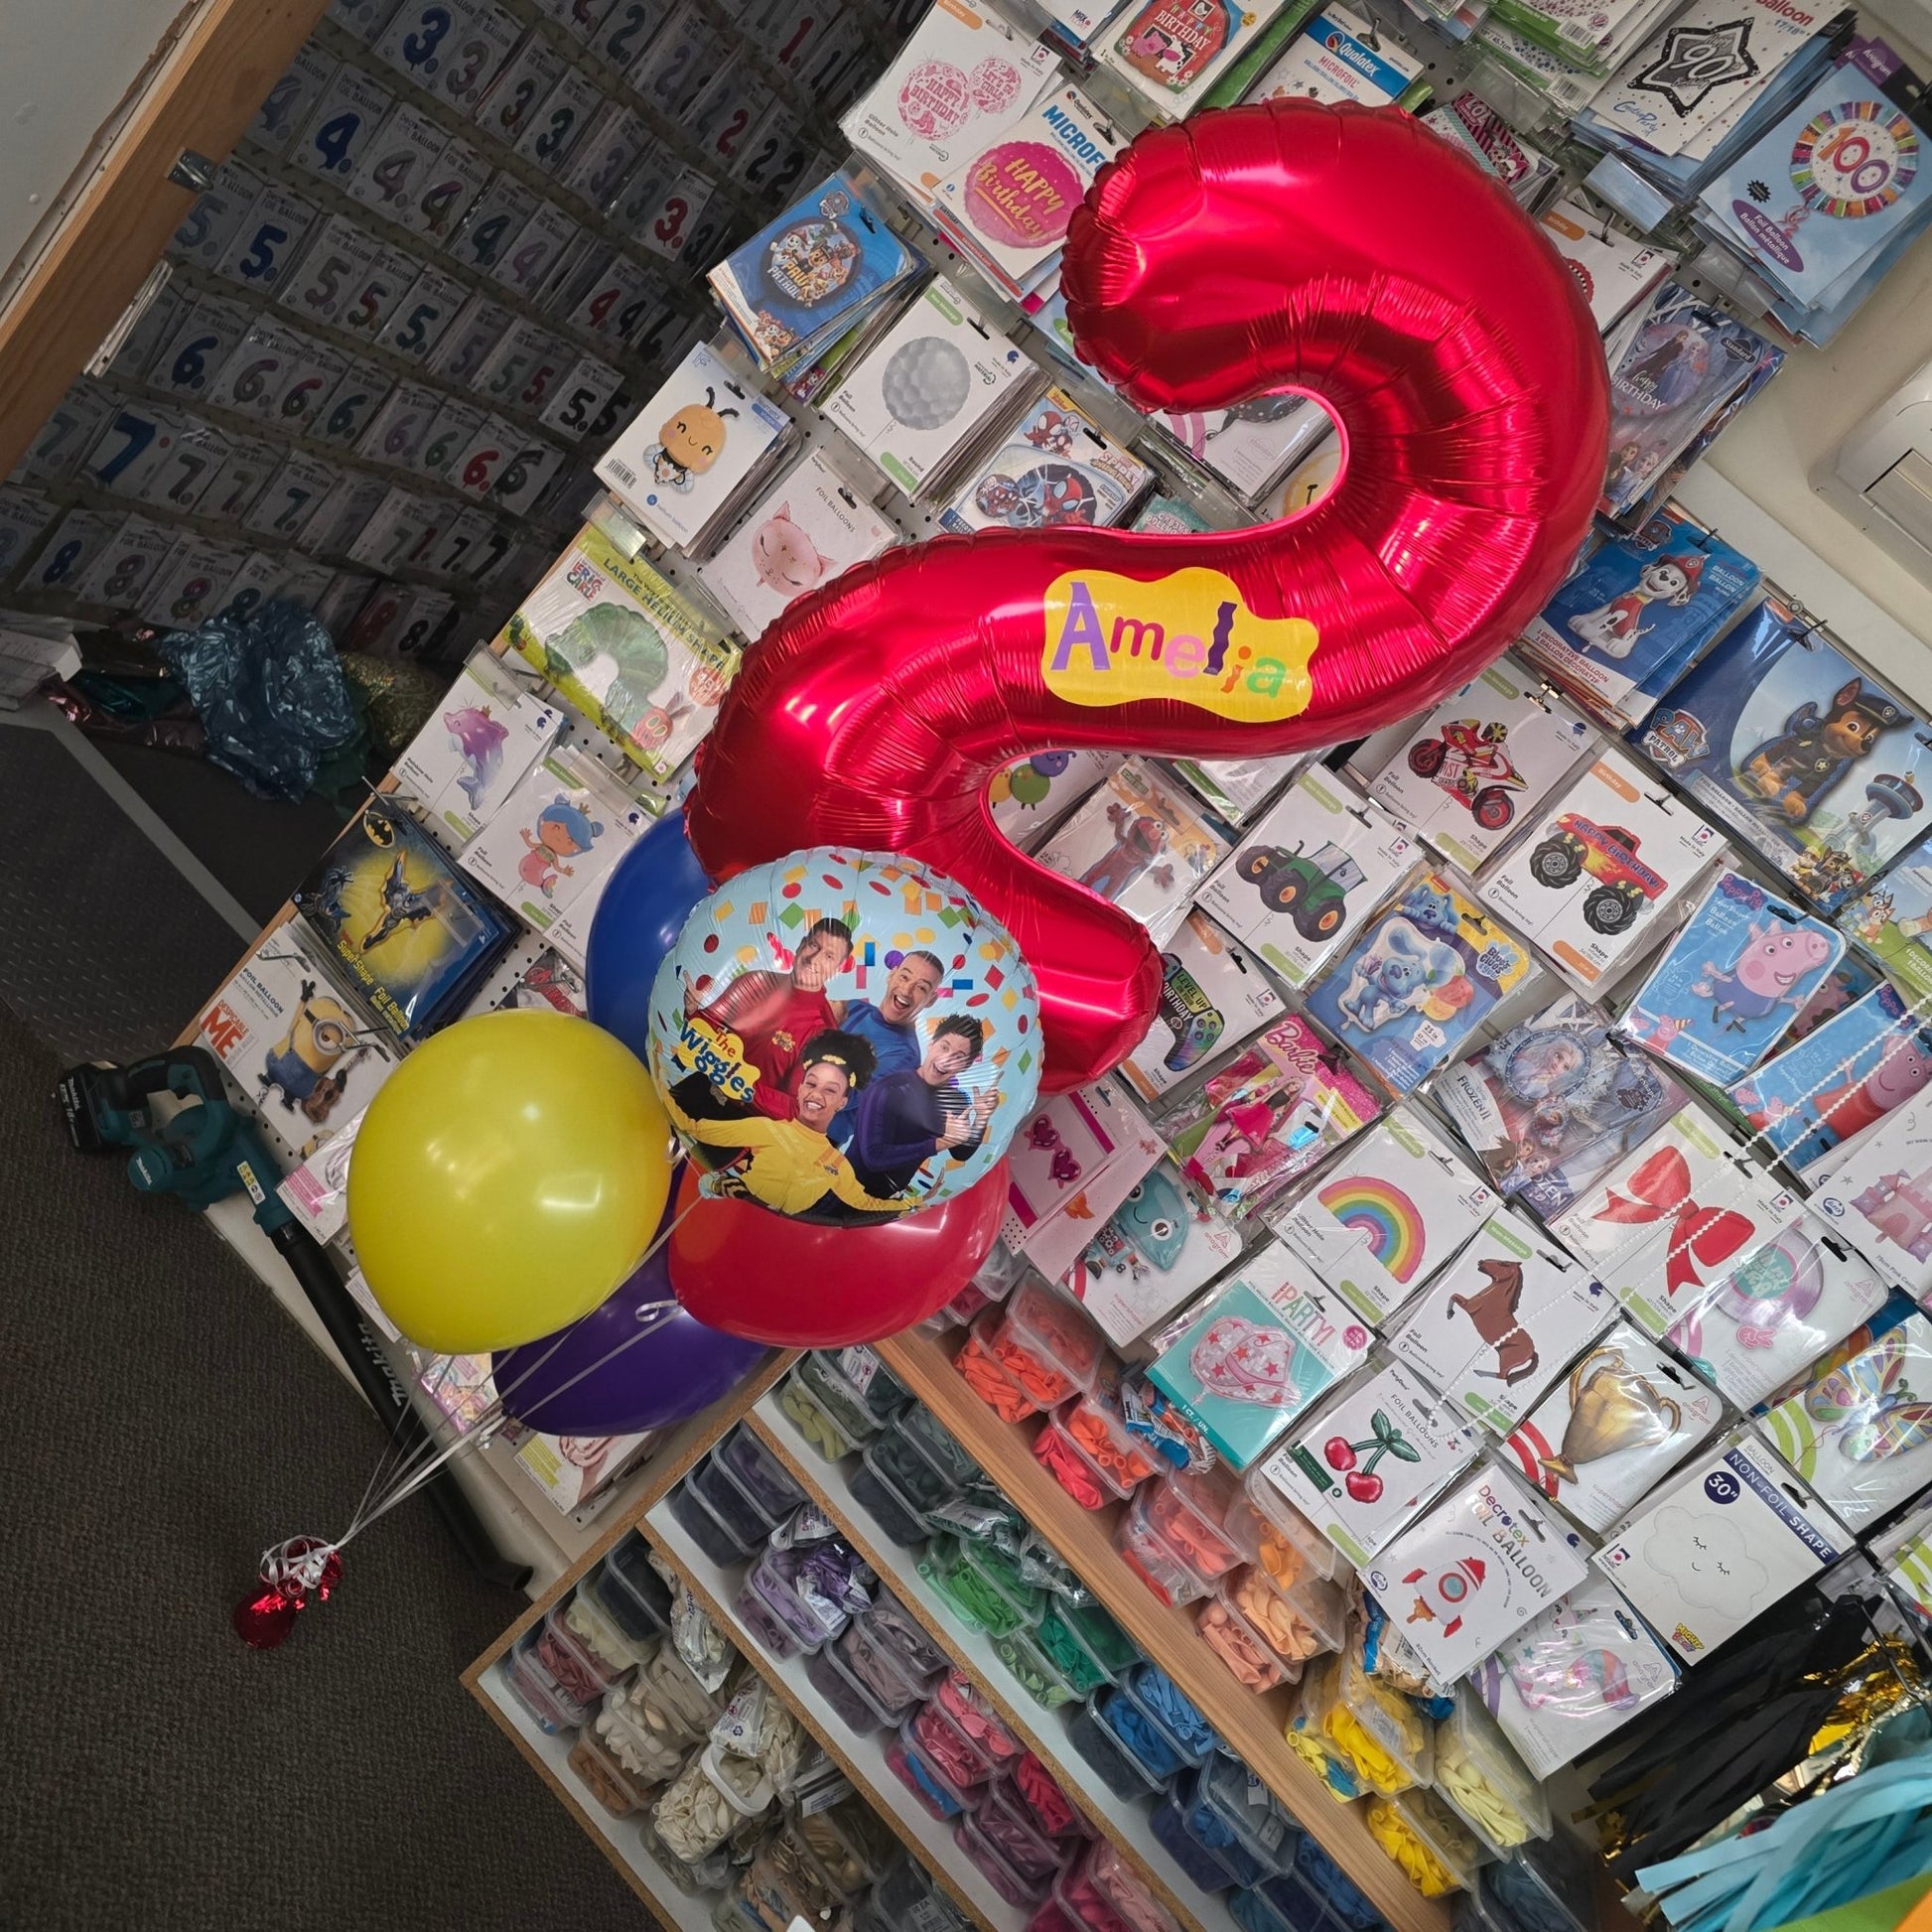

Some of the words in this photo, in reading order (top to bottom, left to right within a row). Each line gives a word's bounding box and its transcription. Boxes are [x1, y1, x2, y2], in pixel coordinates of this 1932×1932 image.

[403, 7, 452, 70] 3
[1154, 9, 1211, 51] BIRTHDAY
[1169, 4, 1212, 37] HAPPY
[1339, 42, 1381, 77] Qualatex
[1669, 44, 1736, 80] 90
[909, 85, 960, 125] BIRTHDAY
[927, 77, 961, 108] HAPPY
[315, 112, 360, 170] 4
[536, 106, 576, 162] 3
[1041, 104, 1108, 171] MICROF
[372, 150, 417, 202] 4
[1817, 125, 1891, 195] 100
[420, 180, 464, 231] 4
[976, 161, 1044, 240] Birthday
[1004, 158, 1065, 215] HAPPY
[239, 223, 288, 279] 5
[1764, 223, 1789, 252] Balloon
[305, 255, 351, 310] 5
[347, 280, 389, 331] 5
[397, 303, 439, 349] 5
[171, 336, 218, 388] 6
[1723, 339, 1756, 363] Standard
[232, 358, 279, 405] 6
[281, 378, 322, 420] 6
[327, 393, 368, 437] 6
[99, 410, 157, 488] 7
[1100, 451, 1140, 486] SPIDEY
[168, 453, 207, 502] 7
[274, 486, 312, 529] 7
[827, 498, 857, 534] BALLOONS
[42, 539, 83, 586] 8
[103, 554, 146, 598] 8
[574, 560, 604, 591] ERIC
[604, 558, 641, 597] LARGE
[566, 571, 598, 602] CARLE
[1708, 573, 1737, 594] BALLON
[1049, 581, 1288, 700] Amelia
[1539, 638, 1564, 659] BALLON
[1540, 630, 1581, 663] DECORATIVE
[1579, 658, 1609, 684] BALLOON
[1648, 734, 1679, 763] PATROL
[1649, 707, 1712, 759] PAW
[1597, 767, 1623, 789] Birthday
[1470, 834, 1488, 850] Shape
[1573, 819, 1608, 847] HAPPY
[1496, 880, 1519, 899] Balloon
[1705, 917, 1729, 936] Ballon
[1710, 906, 1738, 928] Balloon
[1296, 946, 1311, 962] Shape
[1479, 953, 1503, 975] Clues
[1486, 945, 1510, 970] Blue's
[1590, 943, 1609, 959] Shape
[1176, 973, 1197, 999] LEVEL
[1194, 996, 1208, 1010] UP
[200, 1005, 245, 1061] ME
[218, 1000, 251, 1035] DESPICABLE
[679, 1022, 755, 1103] Wiggles
[715, 1027, 737, 1058] The
[1264, 1021, 1317, 1076] Barbie
[1456, 1075, 1486, 1116] FROZEN
[1373, 1285, 1391, 1303] Shape
[1657, 1294, 1678, 1314] Shape
[1405, 1333, 1429, 1354] Balloon
[1196, 1420, 1209, 1436] UN.
[1404, 1409, 1440, 1449] BALLOONS
[1745, 1444, 1776, 1475] BALLOON
[1707, 1473, 1740, 1500] 30"
[1728, 1452, 1788, 1518] NON-FOIL
[1788, 1515, 1833, 1560] SHAPE
[1477, 1484, 1531, 1548] Decrotex
[1491, 1529, 1554, 1599] BALLOON
[1675, 1621, 1706, 1652] MIGHTY
